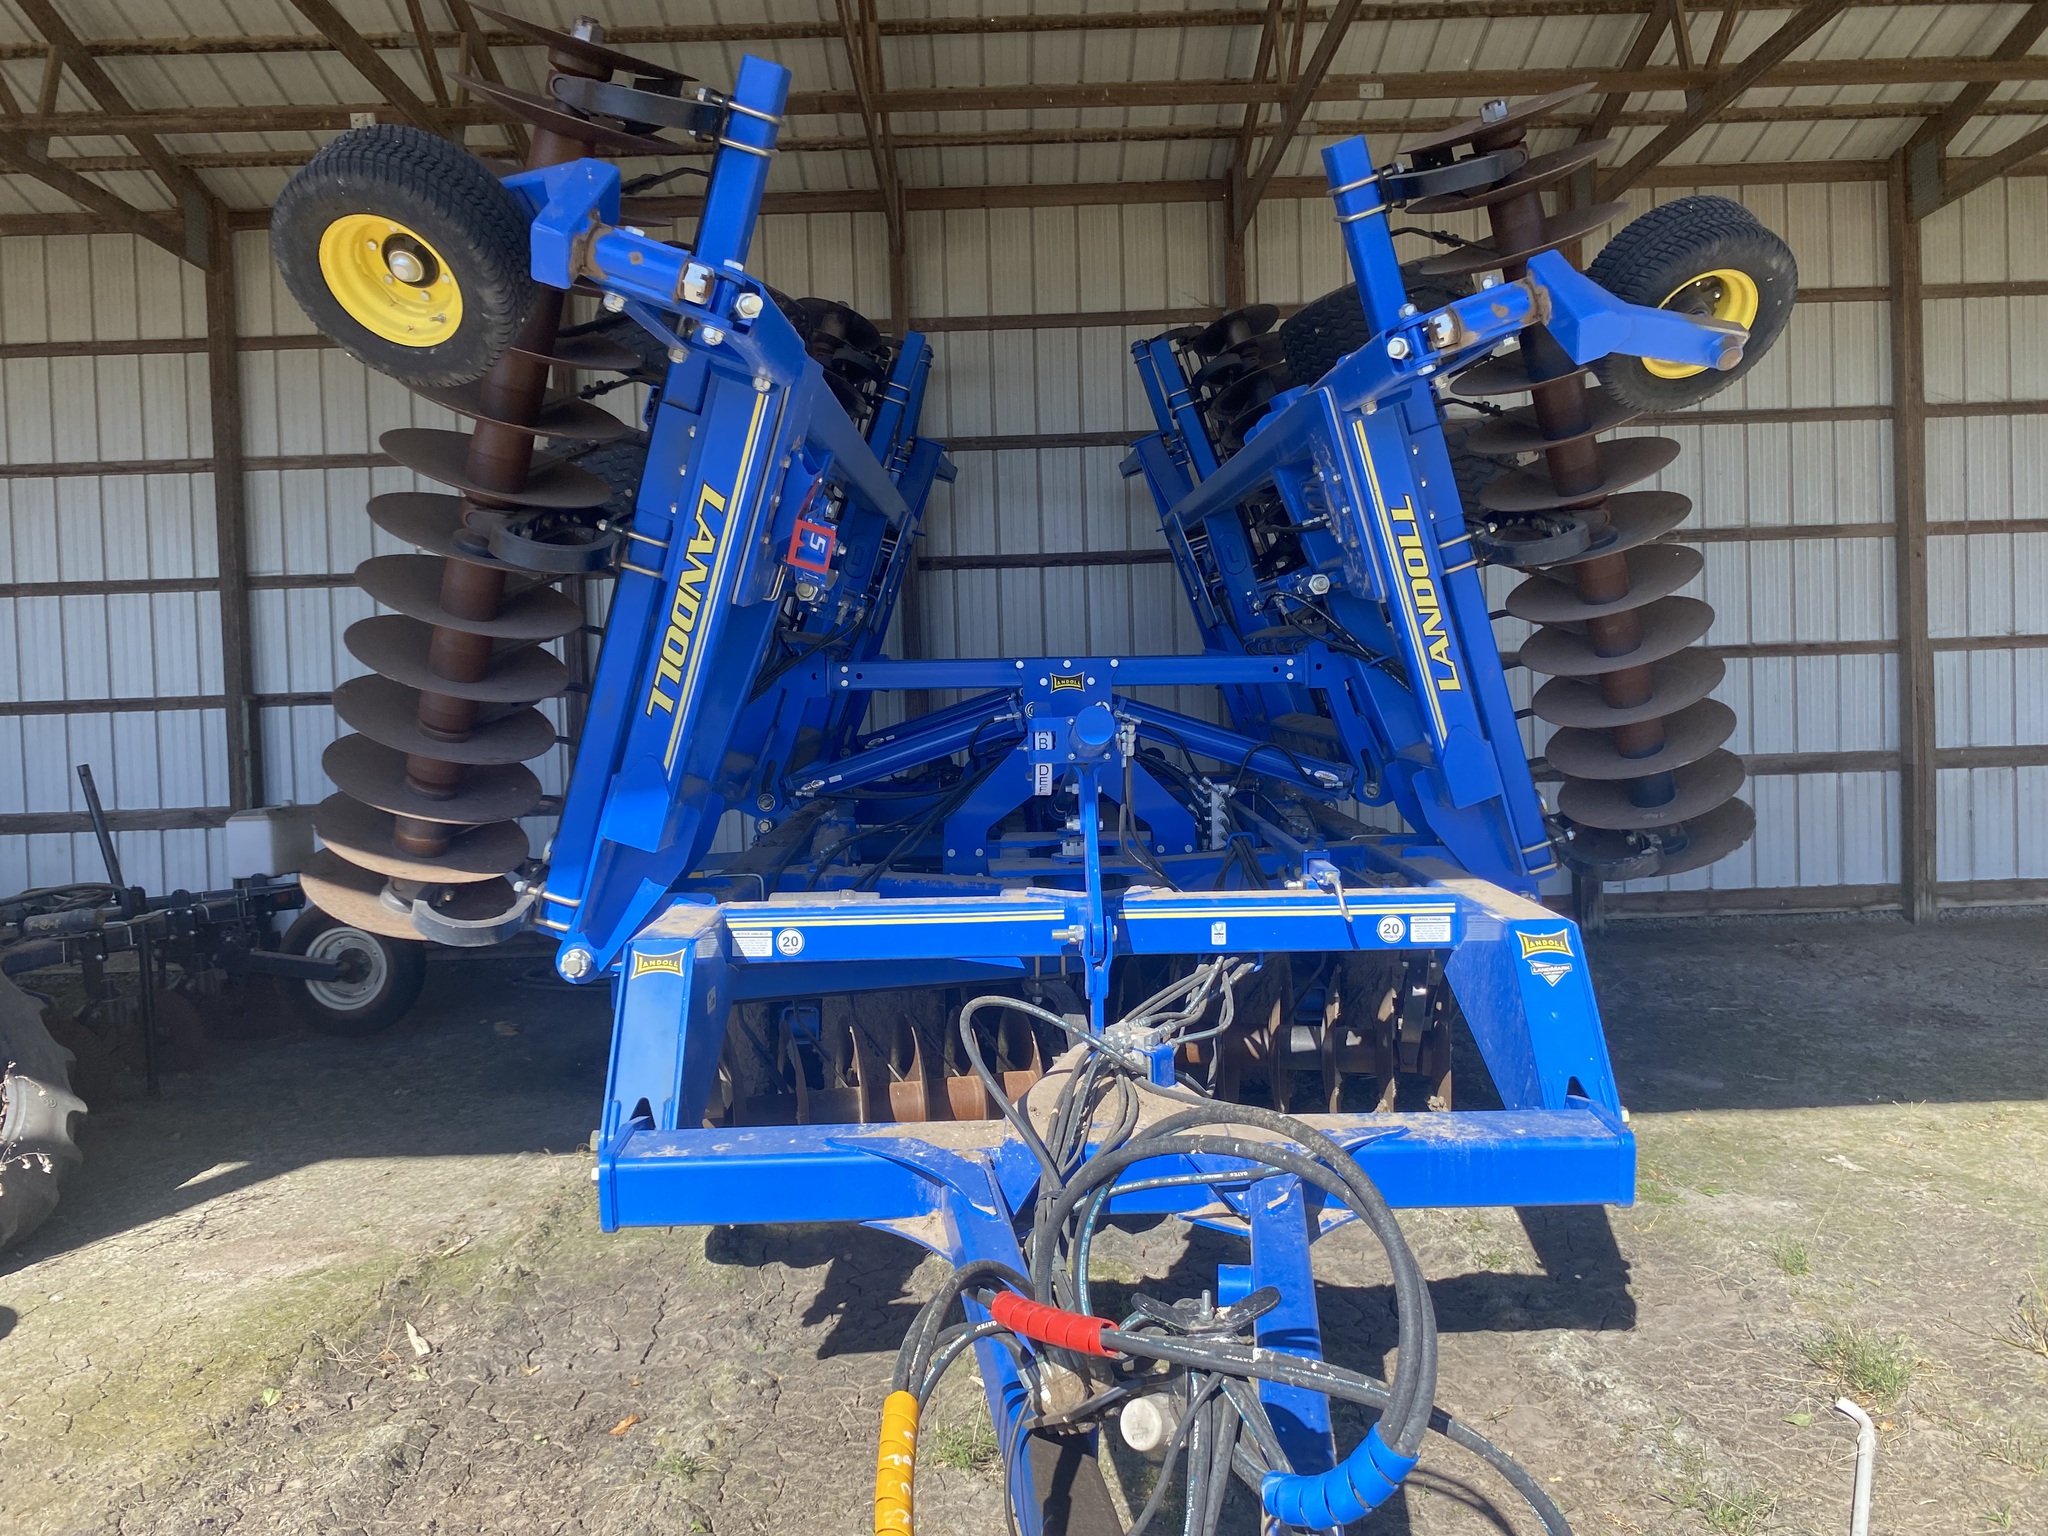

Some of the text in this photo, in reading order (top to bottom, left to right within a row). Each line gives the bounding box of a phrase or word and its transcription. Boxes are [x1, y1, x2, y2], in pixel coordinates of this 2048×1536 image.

[809, 532, 826, 553] 5
[647, 480, 728, 719] LANDOLL
[1389, 495, 1463, 691] LANDOLL
[1053, 677, 1082, 689] LANDOLL
[1383, 923, 1400, 934] 20
[782, 936, 799, 947] 20
[1522, 936, 1567, 952] LANDOLL
[637, 956, 679, 972] LANDOLL
